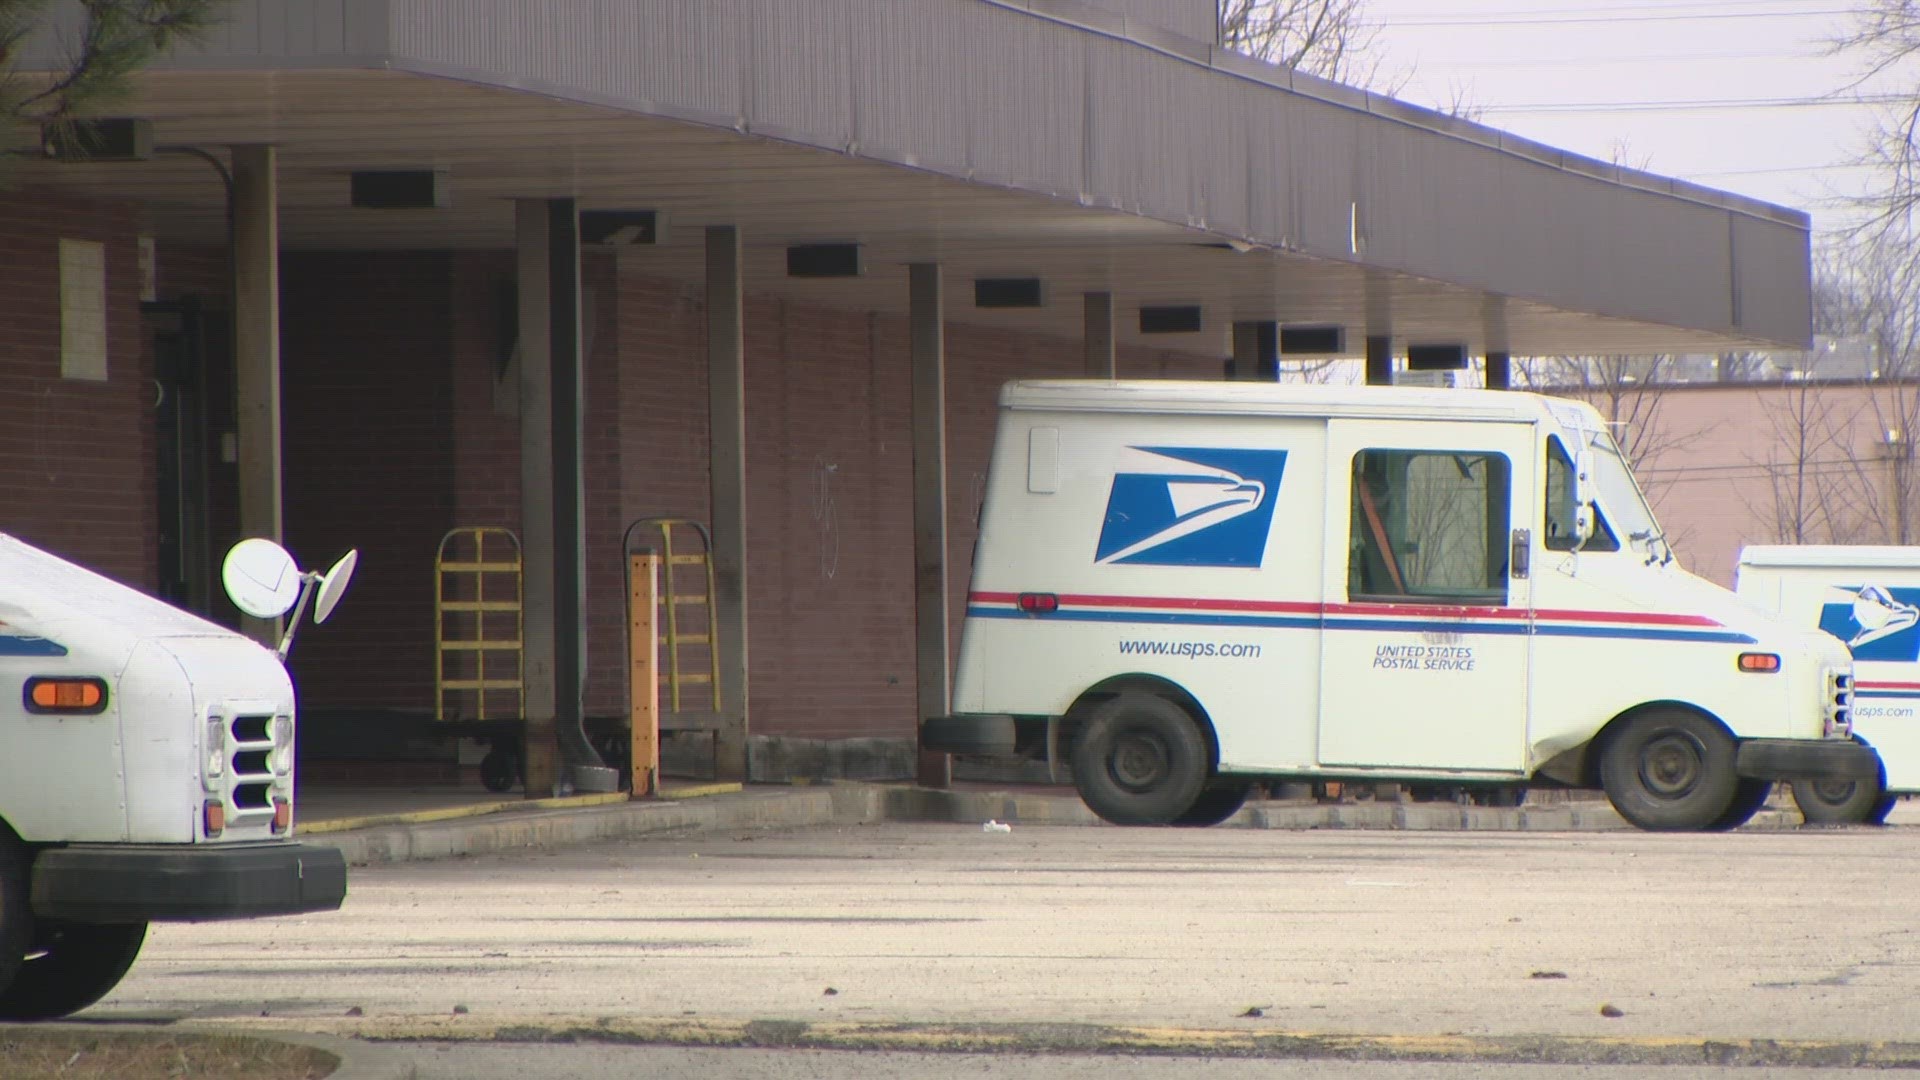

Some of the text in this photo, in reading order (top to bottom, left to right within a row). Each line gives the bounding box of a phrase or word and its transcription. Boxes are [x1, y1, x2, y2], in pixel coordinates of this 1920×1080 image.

[1119, 640, 1262, 660] www.usps.com
[1376, 645, 1473, 658] UNITED STATES
[1373, 658, 1475, 671] POSTAL SERVICE
